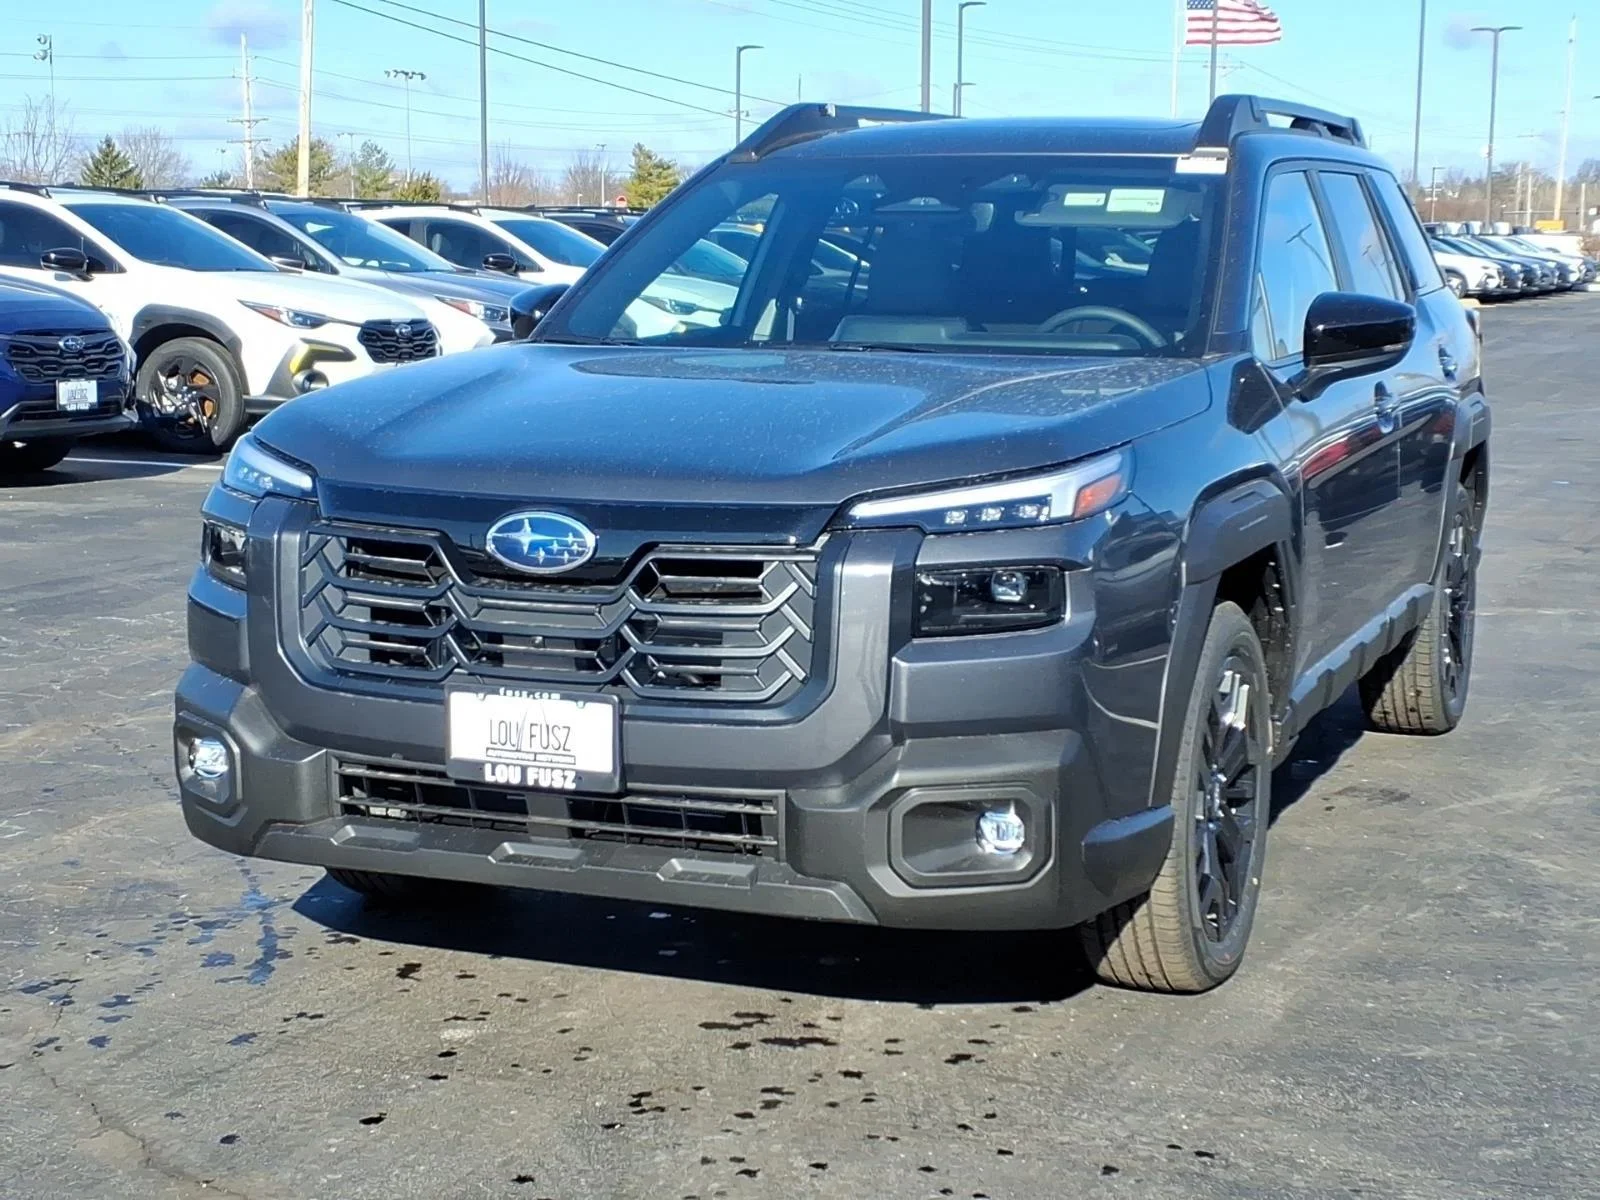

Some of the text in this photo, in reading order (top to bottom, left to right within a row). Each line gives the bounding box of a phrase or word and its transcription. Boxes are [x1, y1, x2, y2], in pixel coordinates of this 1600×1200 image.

[489, 719, 572, 752] LOU FUSZ
[484, 761, 577, 790] LOU FUSZ
